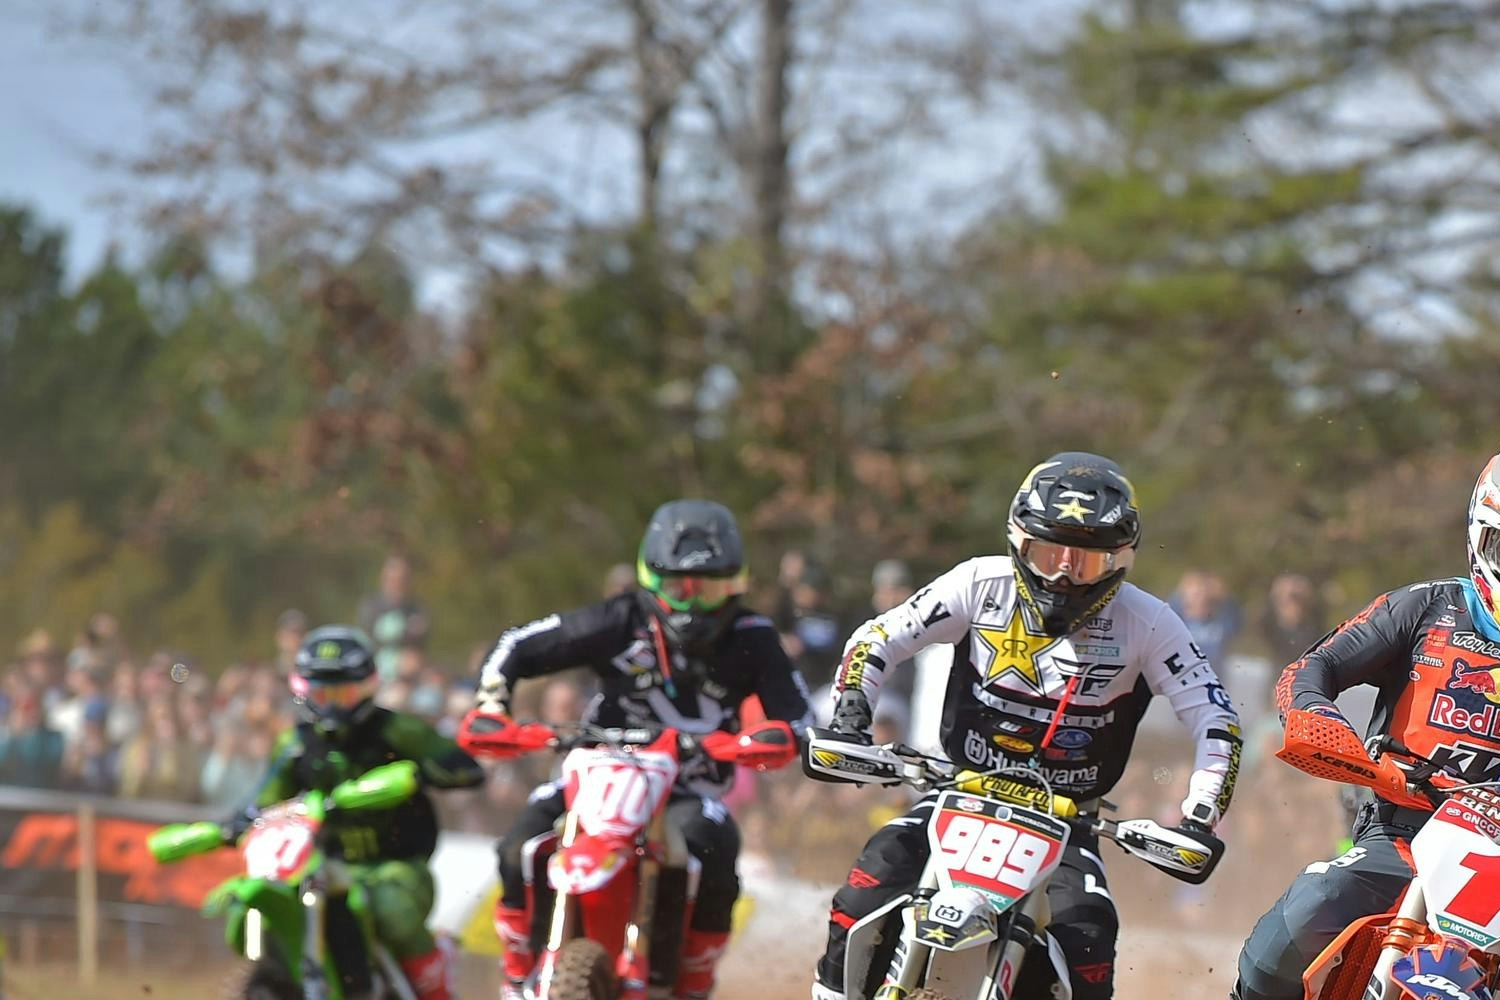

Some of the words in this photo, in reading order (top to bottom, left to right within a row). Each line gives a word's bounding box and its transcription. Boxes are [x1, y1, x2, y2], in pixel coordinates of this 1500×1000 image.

[1432, 694, 1490, 735] Red
[1310, 751, 1377, 780] ACERBIS
[941, 815, 1050, 889] 989
[1450, 923, 1489, 944] MOTOREX
